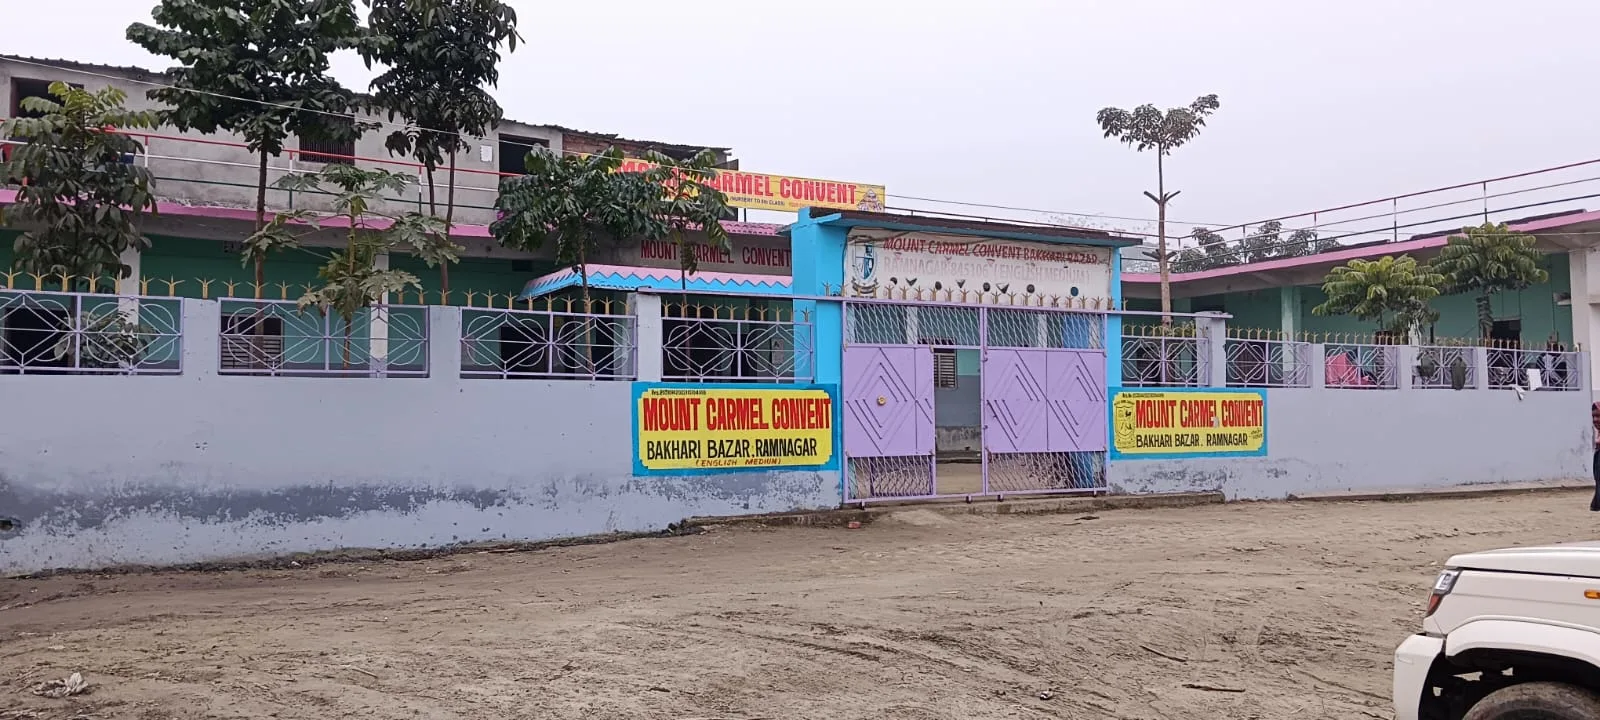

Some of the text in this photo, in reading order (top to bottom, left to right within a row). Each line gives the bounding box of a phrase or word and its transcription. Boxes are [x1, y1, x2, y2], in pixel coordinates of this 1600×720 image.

[779, 178, 857, 204] CONVENT
[641, 240, 678, 260] MOUNT
[742, 246, 791, 267] CONVENT
[884, 238, 925, 253] MOUNT
[928, 241, 970, 256] CARMEL
[973, 244, 1021, 260] CONVENT
[643, 397, 832, 431] MOUNT CARMEL CONVENT
[1136, 400, 1176, 429] MOUNT
[1221, 400, 1263, 427] CONVENT
[647, 440, 701, 460] BAKHARI
[1136, 434, 1172, 448] BAKHARI
[1206, 433, 1248, 447] RAMNAGAR
[695, 459, 737, 467] (ENGLISH
